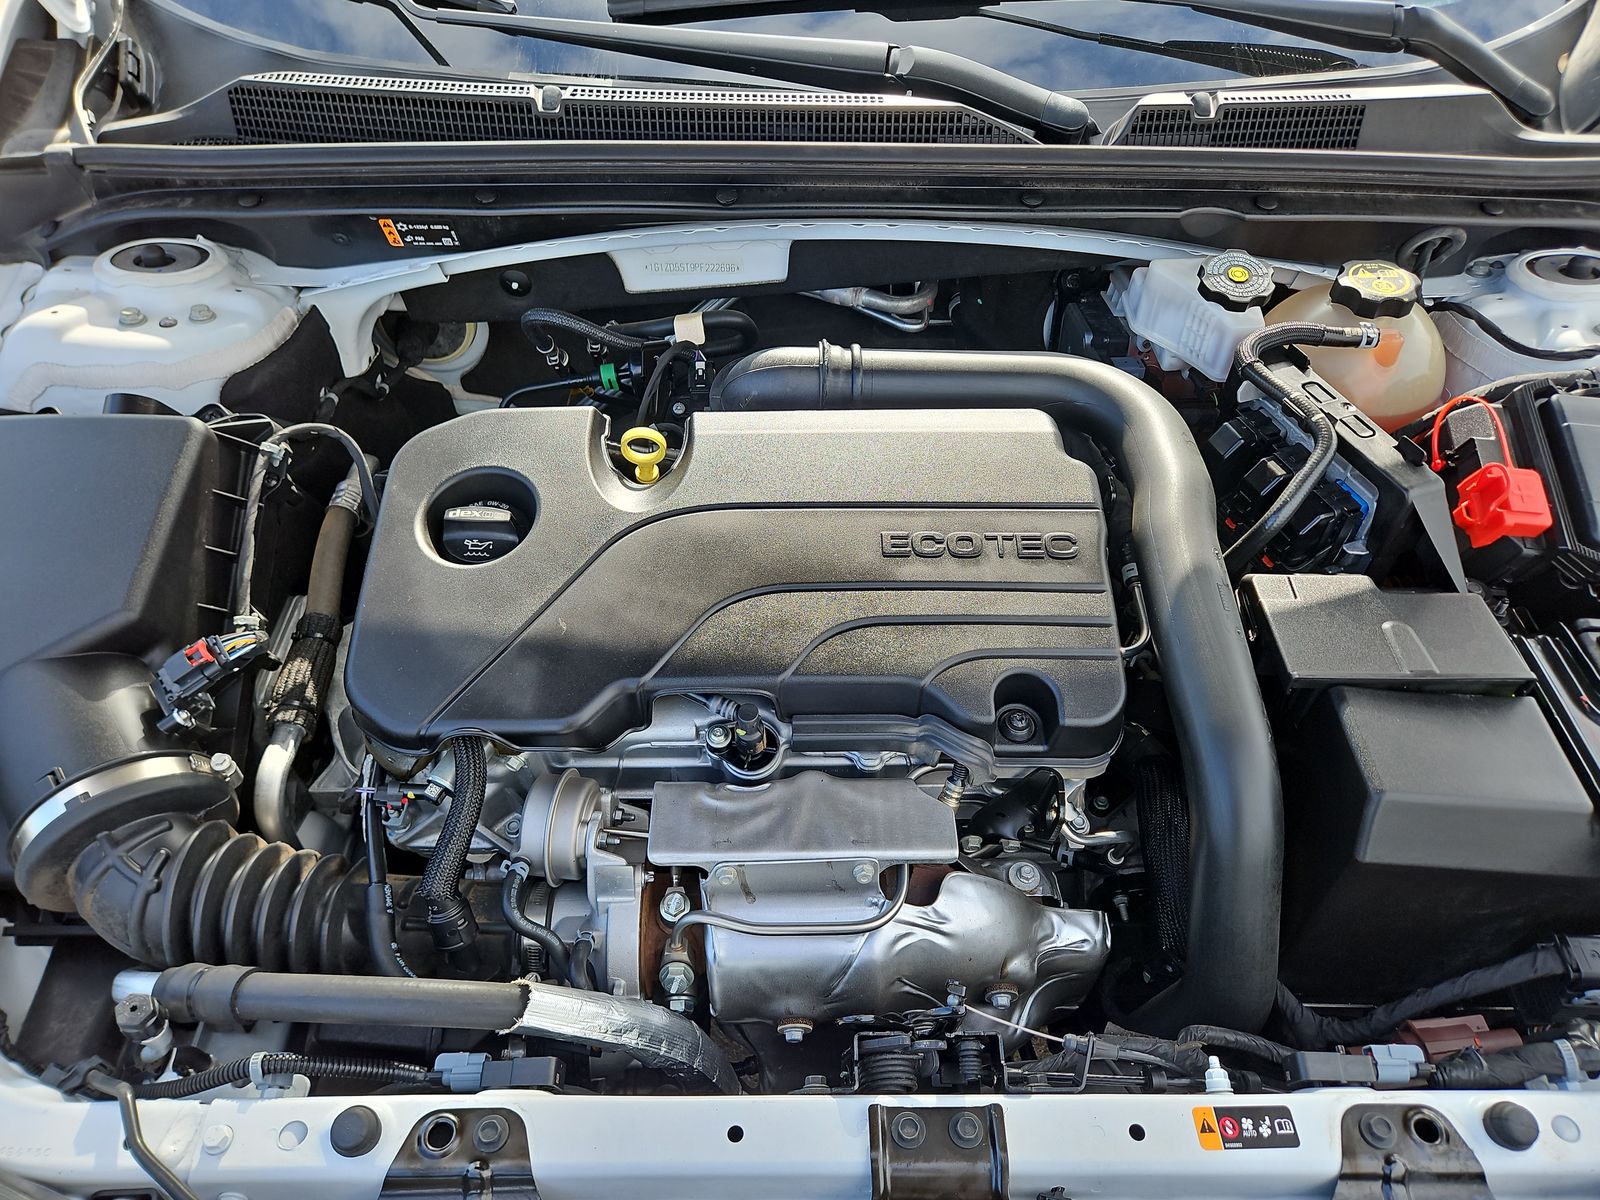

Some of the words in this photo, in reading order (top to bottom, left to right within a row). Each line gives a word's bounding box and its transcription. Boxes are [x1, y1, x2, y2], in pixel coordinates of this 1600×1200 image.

[487, 500, 509, 510] 0W-20
[881, 531, 1079, 560] ECOTEC
[1243, 1129, 1257, 1137] AUTO
